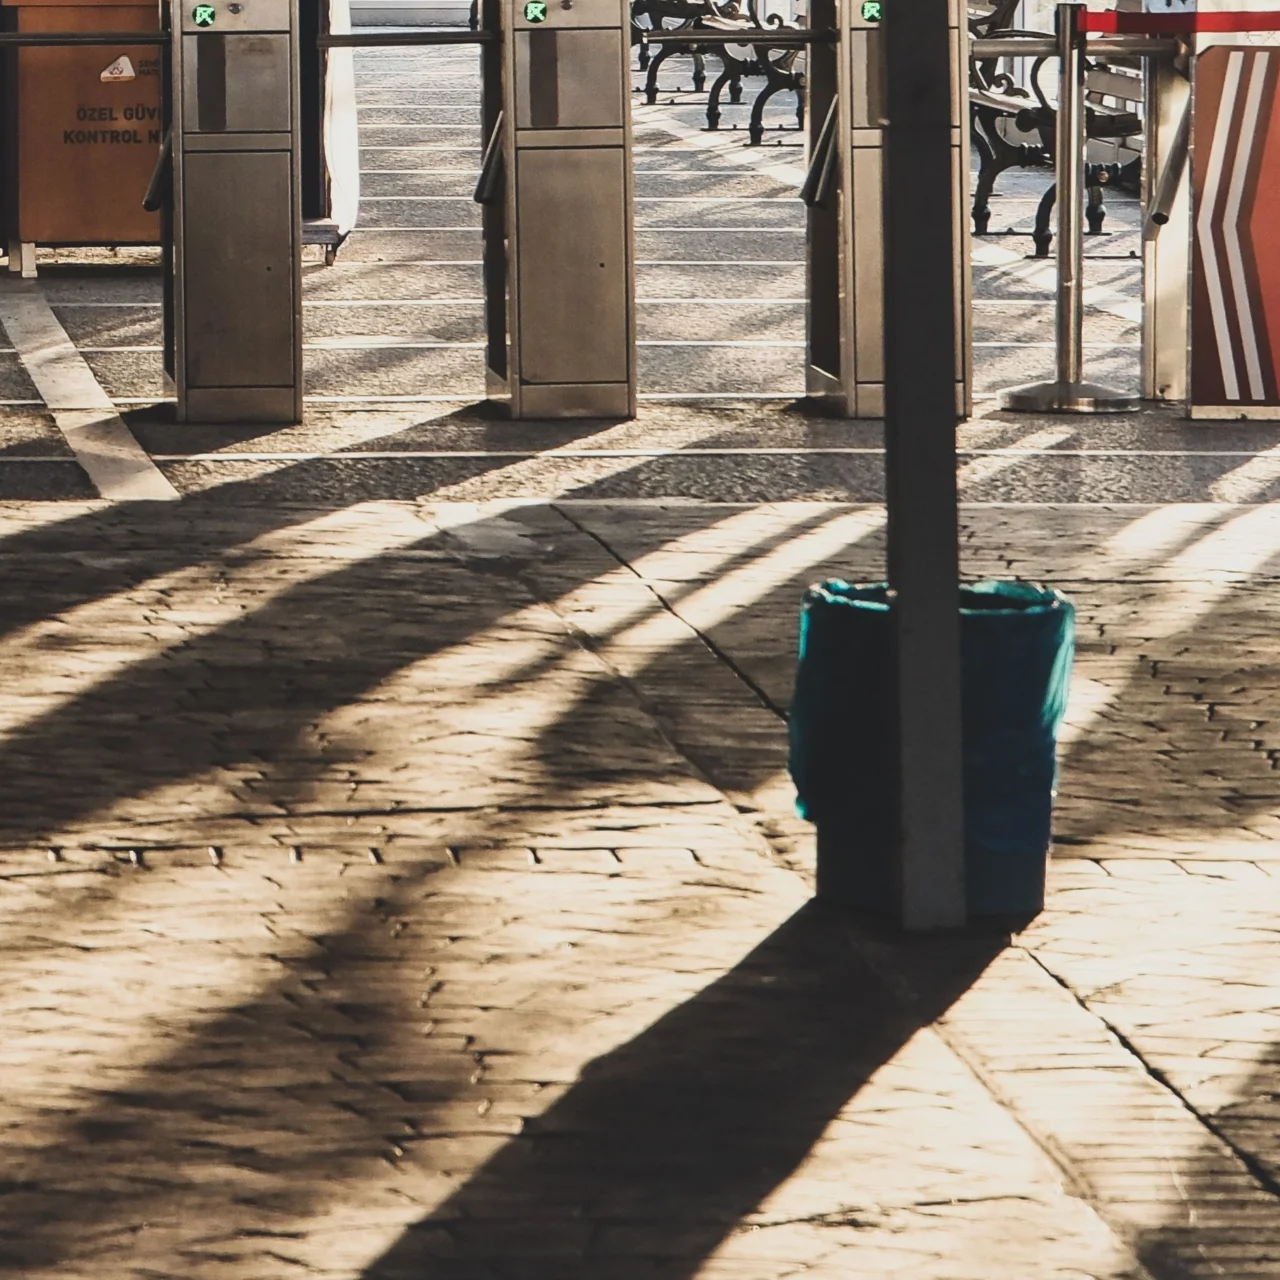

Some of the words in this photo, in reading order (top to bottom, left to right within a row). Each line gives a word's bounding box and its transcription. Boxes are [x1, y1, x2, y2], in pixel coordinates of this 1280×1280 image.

[76, 104, 118, 121] ÖZEL
[123, 104, 161, 121] GÜV
[63, 130, 143, 144] KONTROL
[148, 130, 161, 144] N
